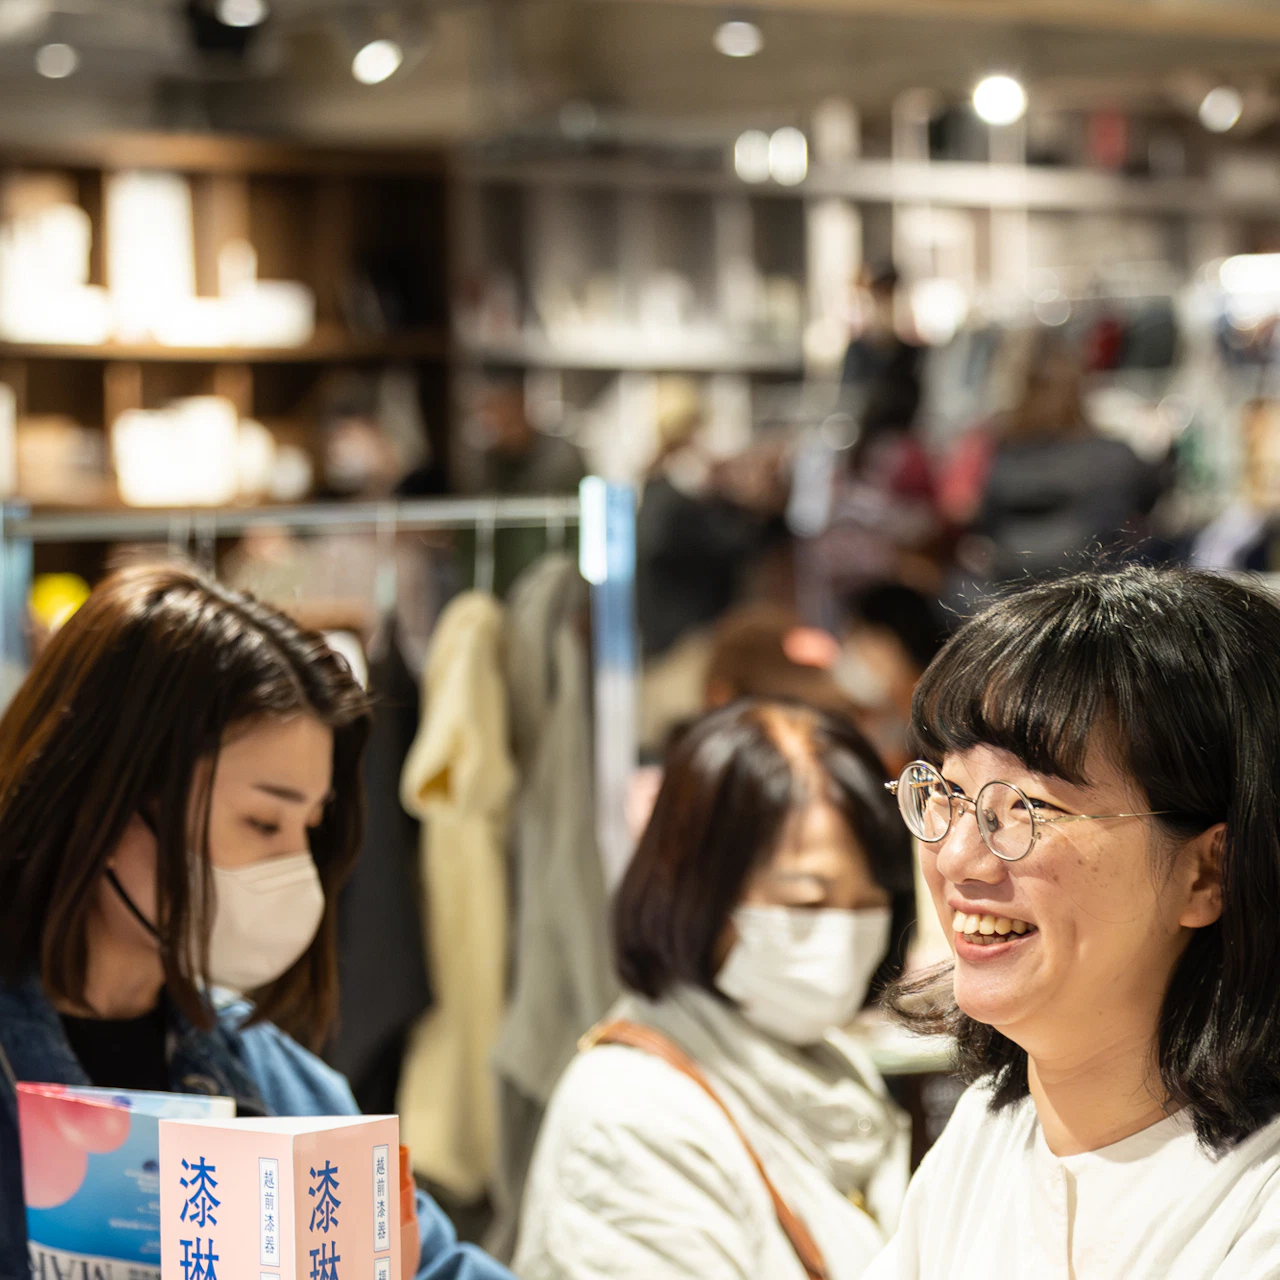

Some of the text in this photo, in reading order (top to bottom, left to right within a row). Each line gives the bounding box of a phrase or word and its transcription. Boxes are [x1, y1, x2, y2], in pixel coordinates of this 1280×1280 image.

[263, 1169, 275, 1254] 越前漆器
[376, 1156, 386, 1240] 越前漆器
